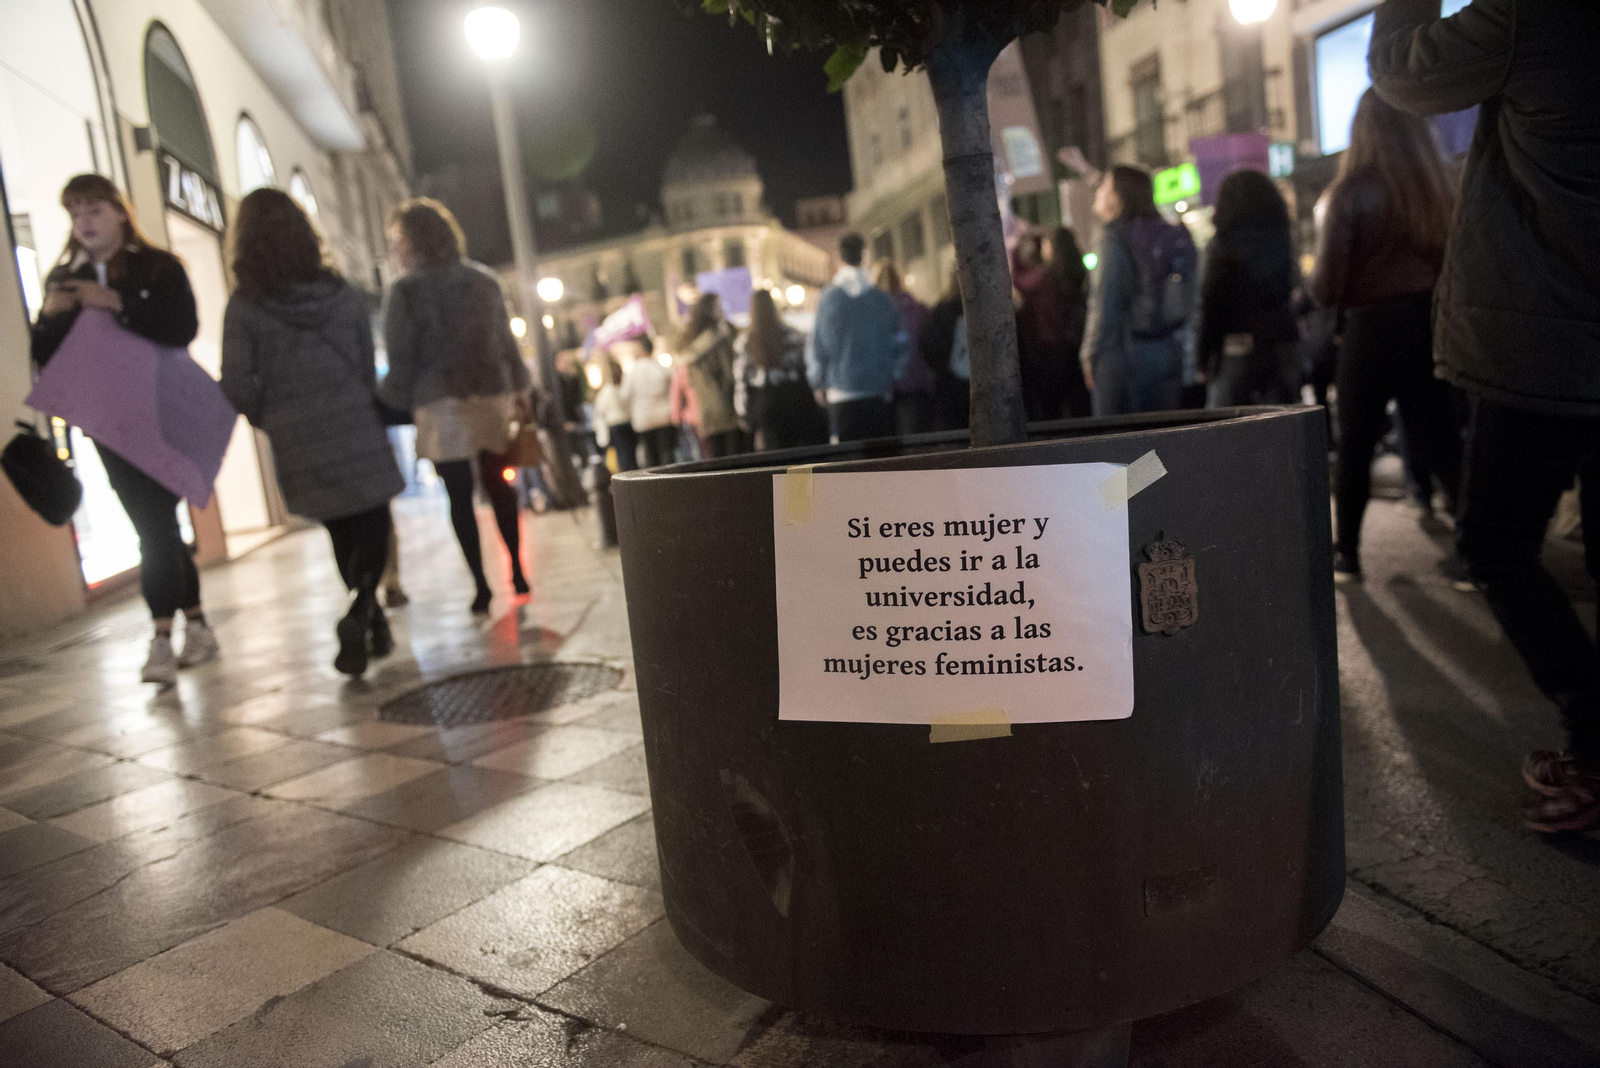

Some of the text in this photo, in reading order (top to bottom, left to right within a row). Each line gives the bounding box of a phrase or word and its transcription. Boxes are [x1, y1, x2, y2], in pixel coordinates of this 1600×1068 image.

[847, 513, 1050, 543] Si eres mujer y
[858, 545, 1041, 579] puedes ir a la
[865, 581, 1035, 609] universidad,
[851, 616, 1052, 648] es gracias a las
[823, 651, 1084, 680] mujeres feministas.
